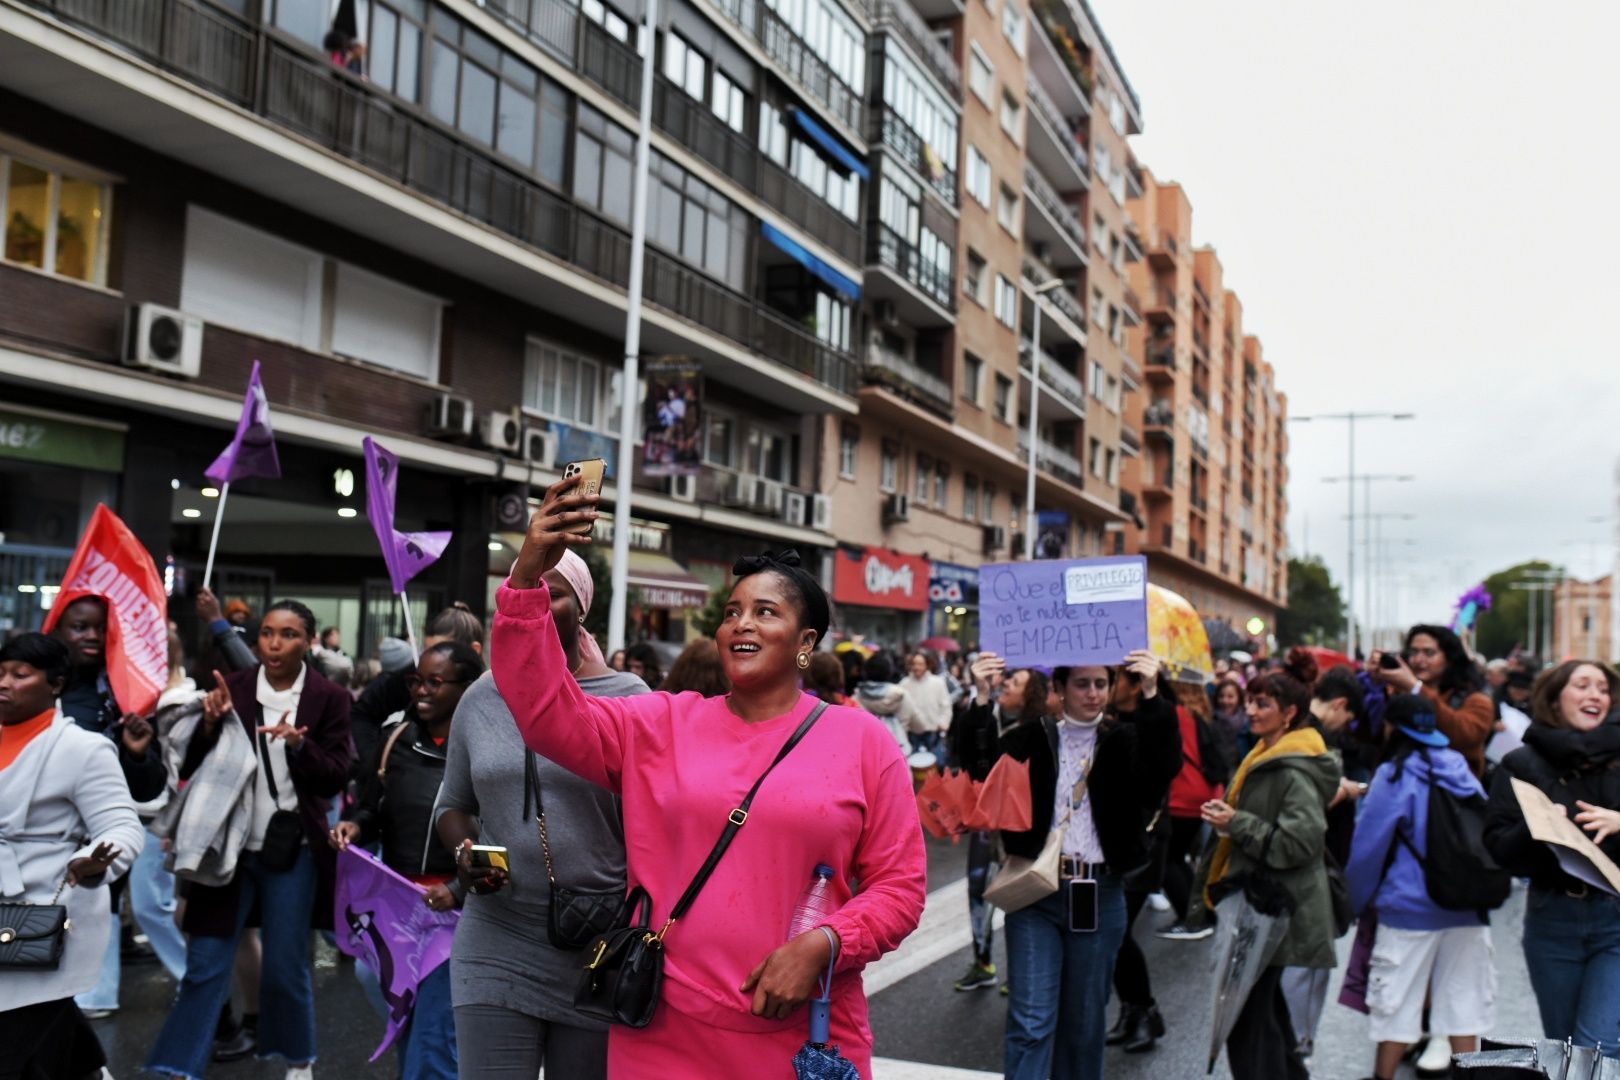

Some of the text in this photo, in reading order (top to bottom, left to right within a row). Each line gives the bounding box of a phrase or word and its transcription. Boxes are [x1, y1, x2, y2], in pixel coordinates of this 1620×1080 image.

[993, 571, 1044, 601] Que
[1068, 567, 1142, 588] PRIVILEGIO
[996, 613, 1013, 628] no
[1017, 605, 1032, 622] te
[1087, 601, 1110, 618] la
